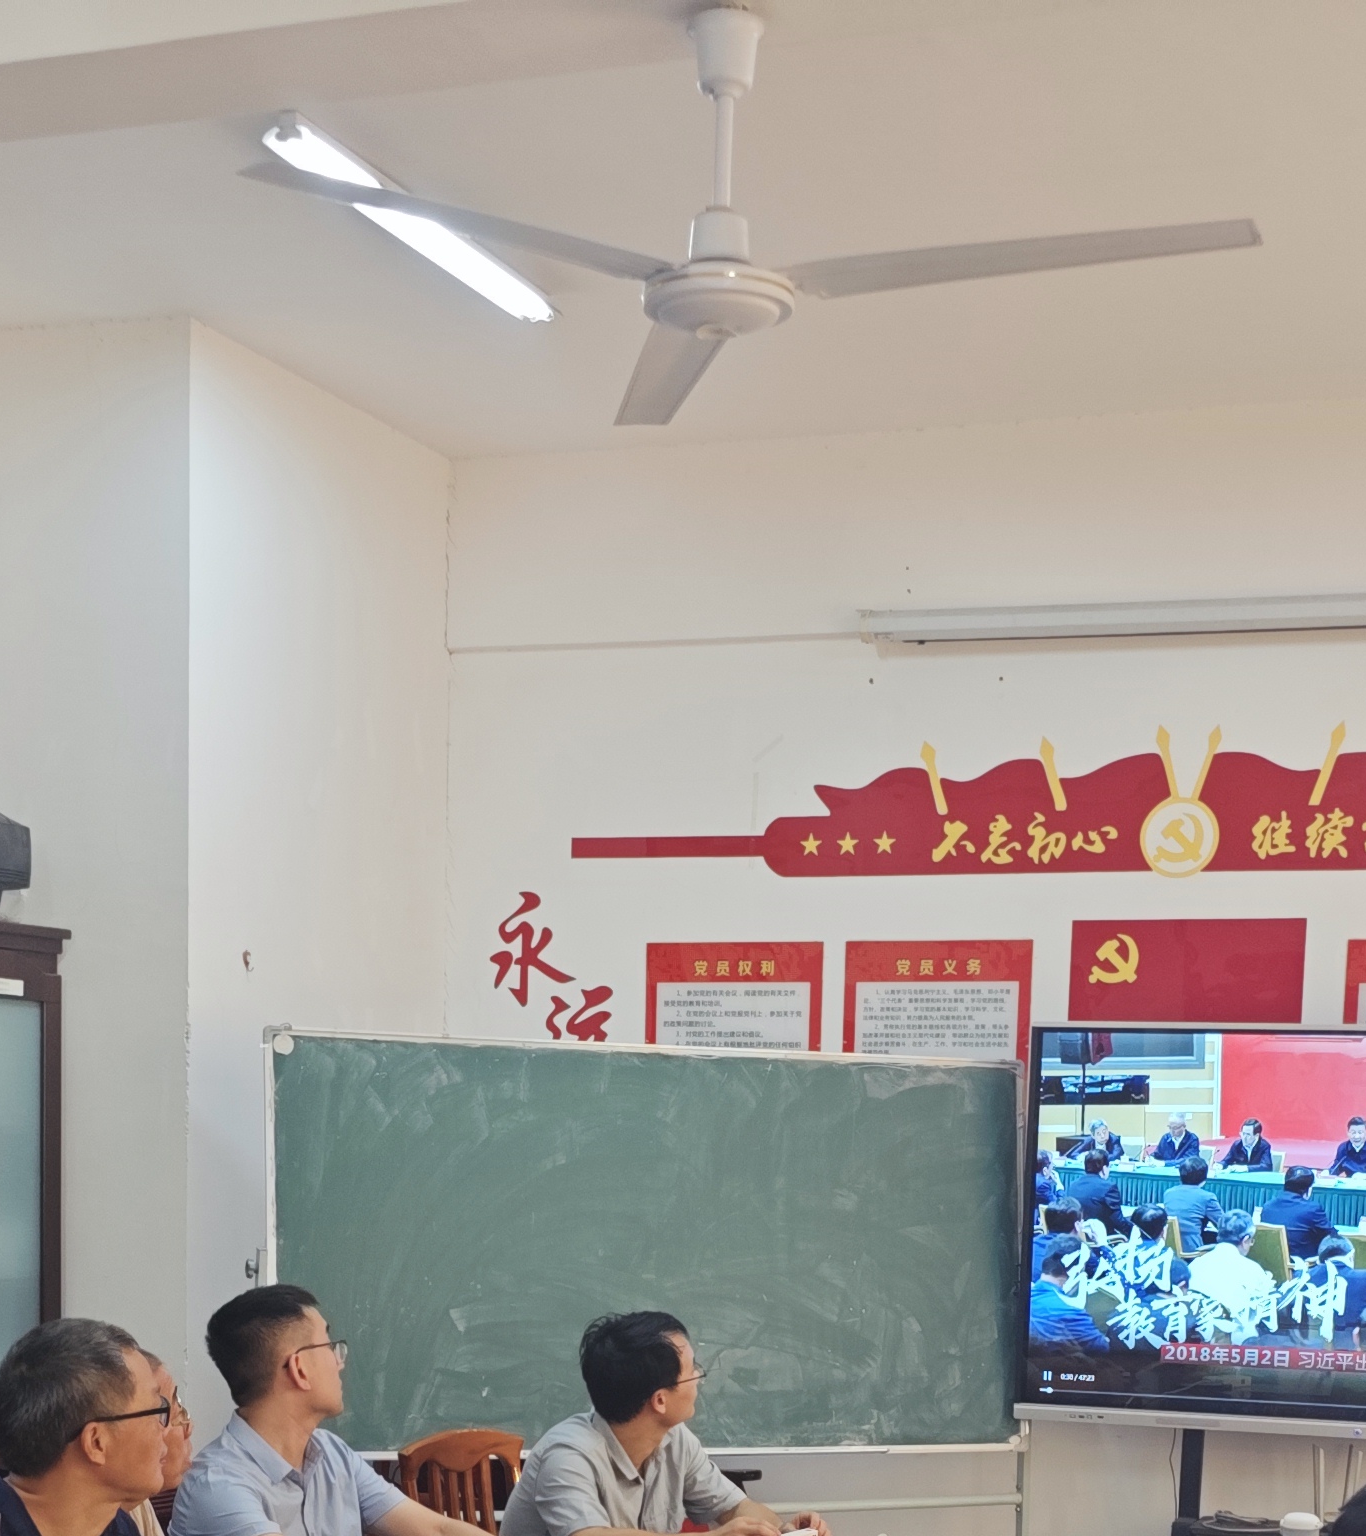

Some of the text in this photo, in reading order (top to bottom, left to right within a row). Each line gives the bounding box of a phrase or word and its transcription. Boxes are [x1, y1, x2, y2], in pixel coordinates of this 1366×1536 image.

[932, 812, 1118, 865] 不忘初心
[694, 960, 775, 977] 党员权利
[895, 958, 982, 976] 党员义务
[1107, 1256, 1348, 1349] 教育家精神
[1164, 1345, 1290, 1367] 2018年5月2日
